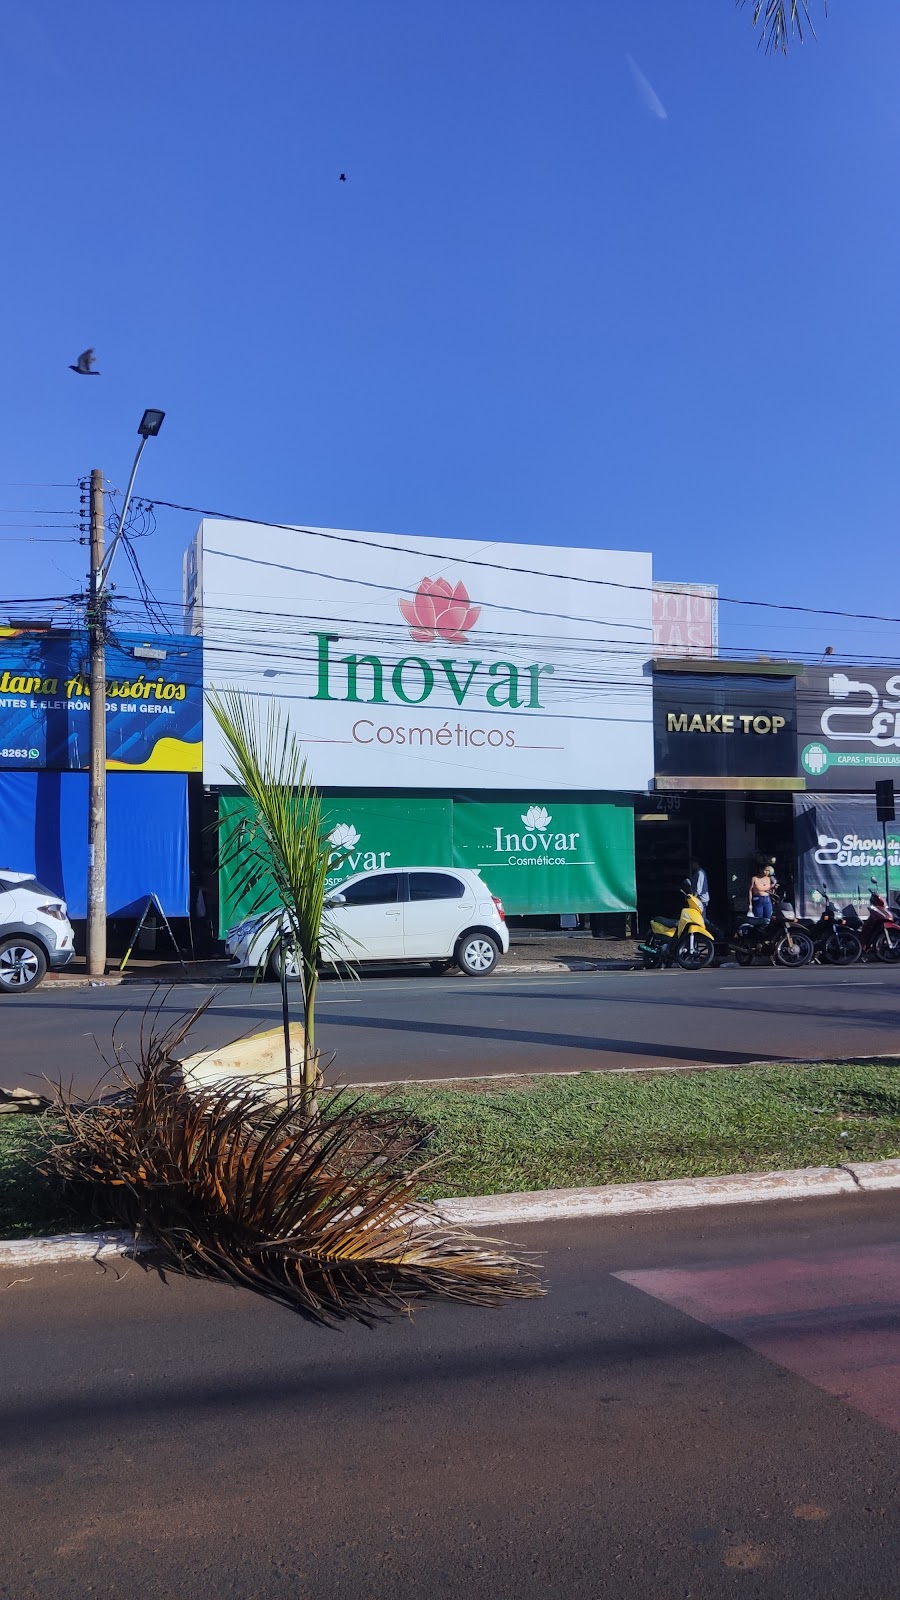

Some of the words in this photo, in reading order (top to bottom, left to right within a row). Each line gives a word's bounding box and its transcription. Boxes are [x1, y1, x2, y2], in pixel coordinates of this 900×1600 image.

[309, 632, 555, 709] Inovar
[40, 700, 118, 712] ELETRÔNOS
[120, 703, 137, 713] EM
[140, 703, 175, 714] GERAL
[352, 719, 516, 747] Cosméticos
[667, 713, 735, 733] MAKE
[739, 715, 786, 734] TOP
[493, 827, 580, 852] Inovar
[842, 834, 885, 851] Show
[508, 855, 566, 866] Cosméticos
